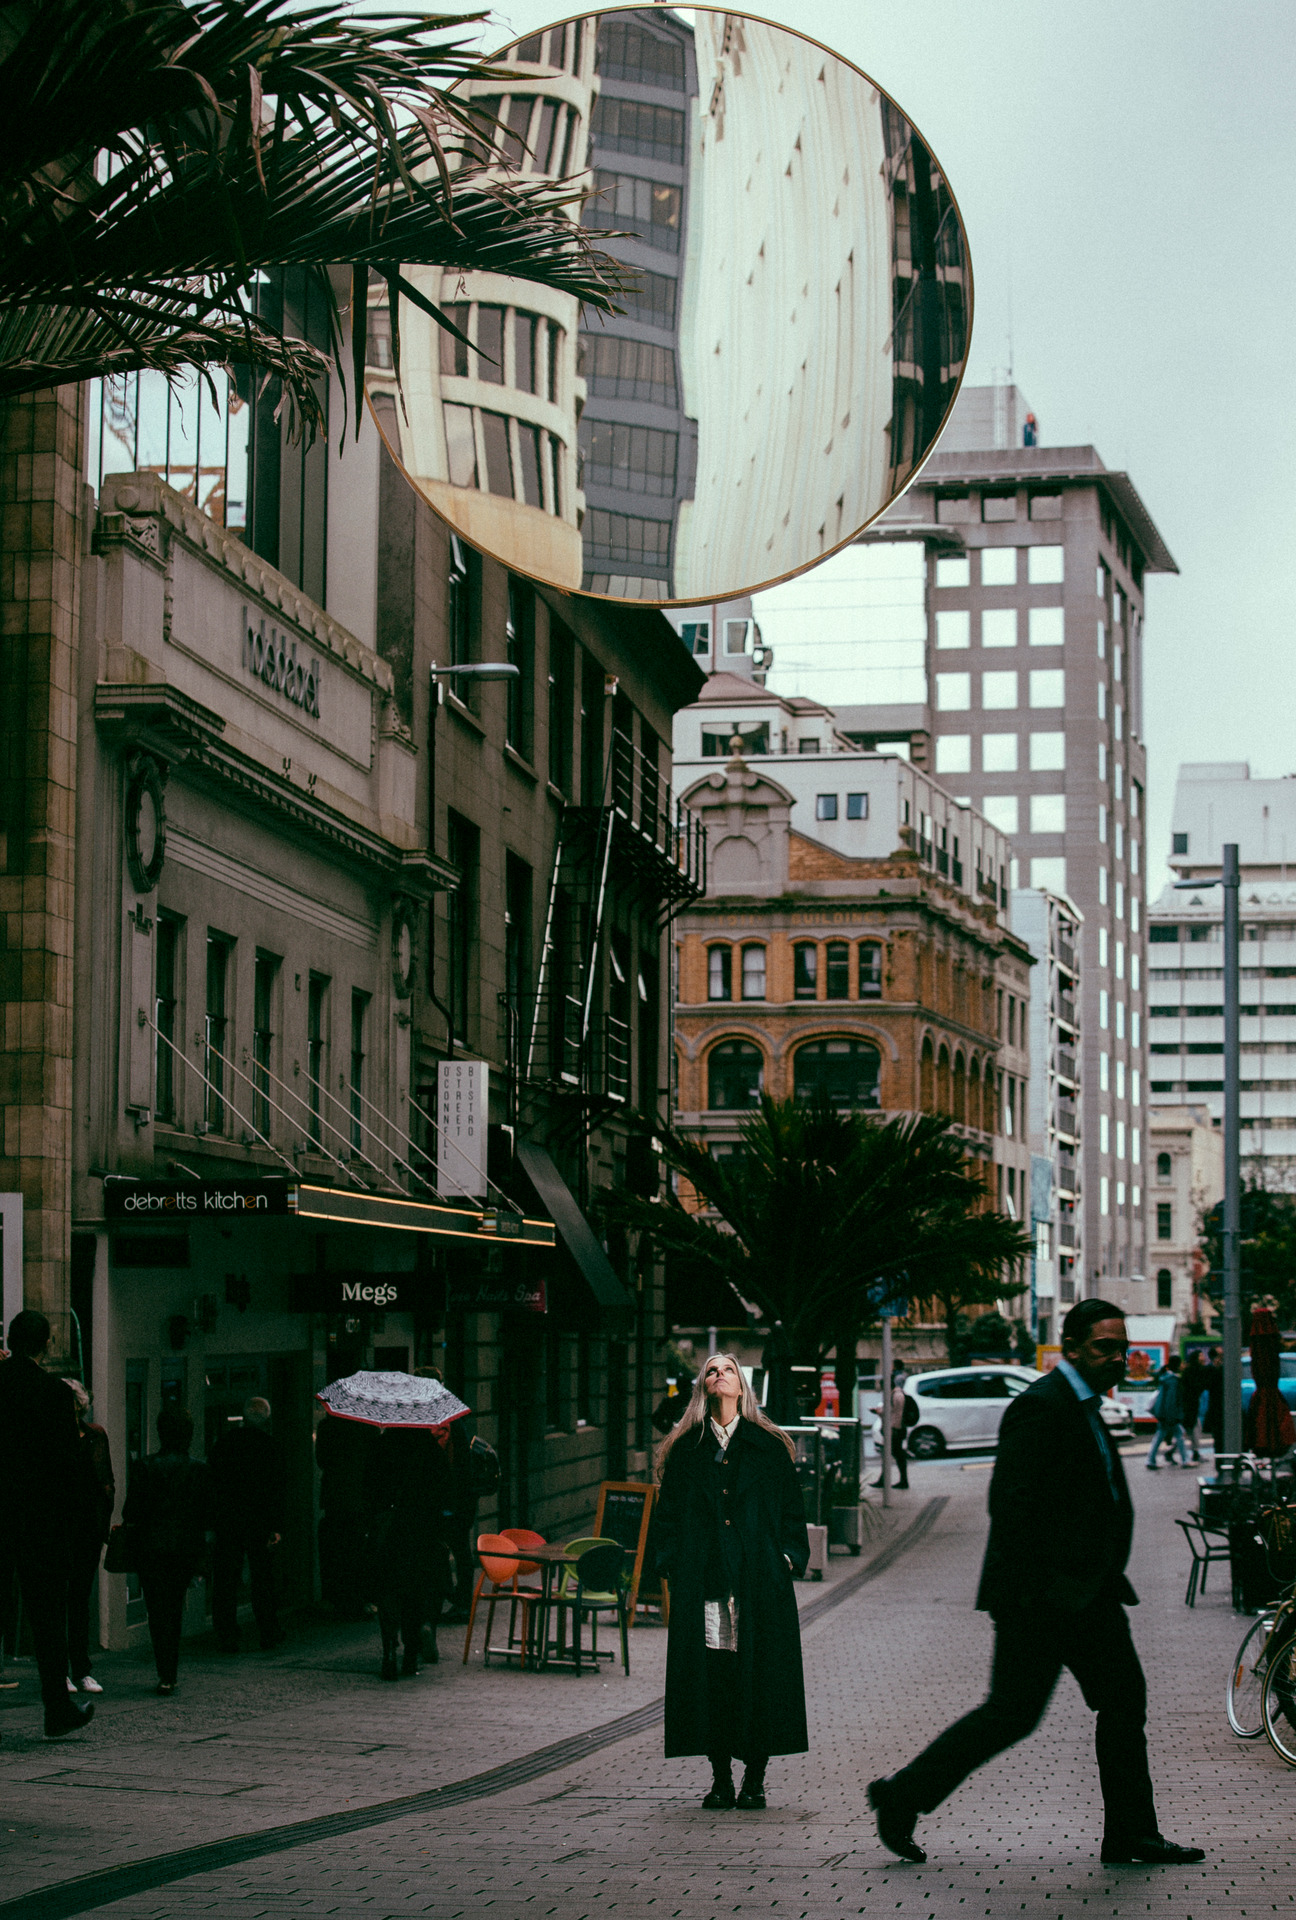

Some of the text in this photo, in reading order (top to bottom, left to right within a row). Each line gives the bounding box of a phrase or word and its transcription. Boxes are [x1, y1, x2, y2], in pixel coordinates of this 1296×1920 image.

[124, 1190, 268, 1211] debretts kitchen
[341, 1282, 398, 1306] Meg's
[514, 1283, 541, 1303] Spa
